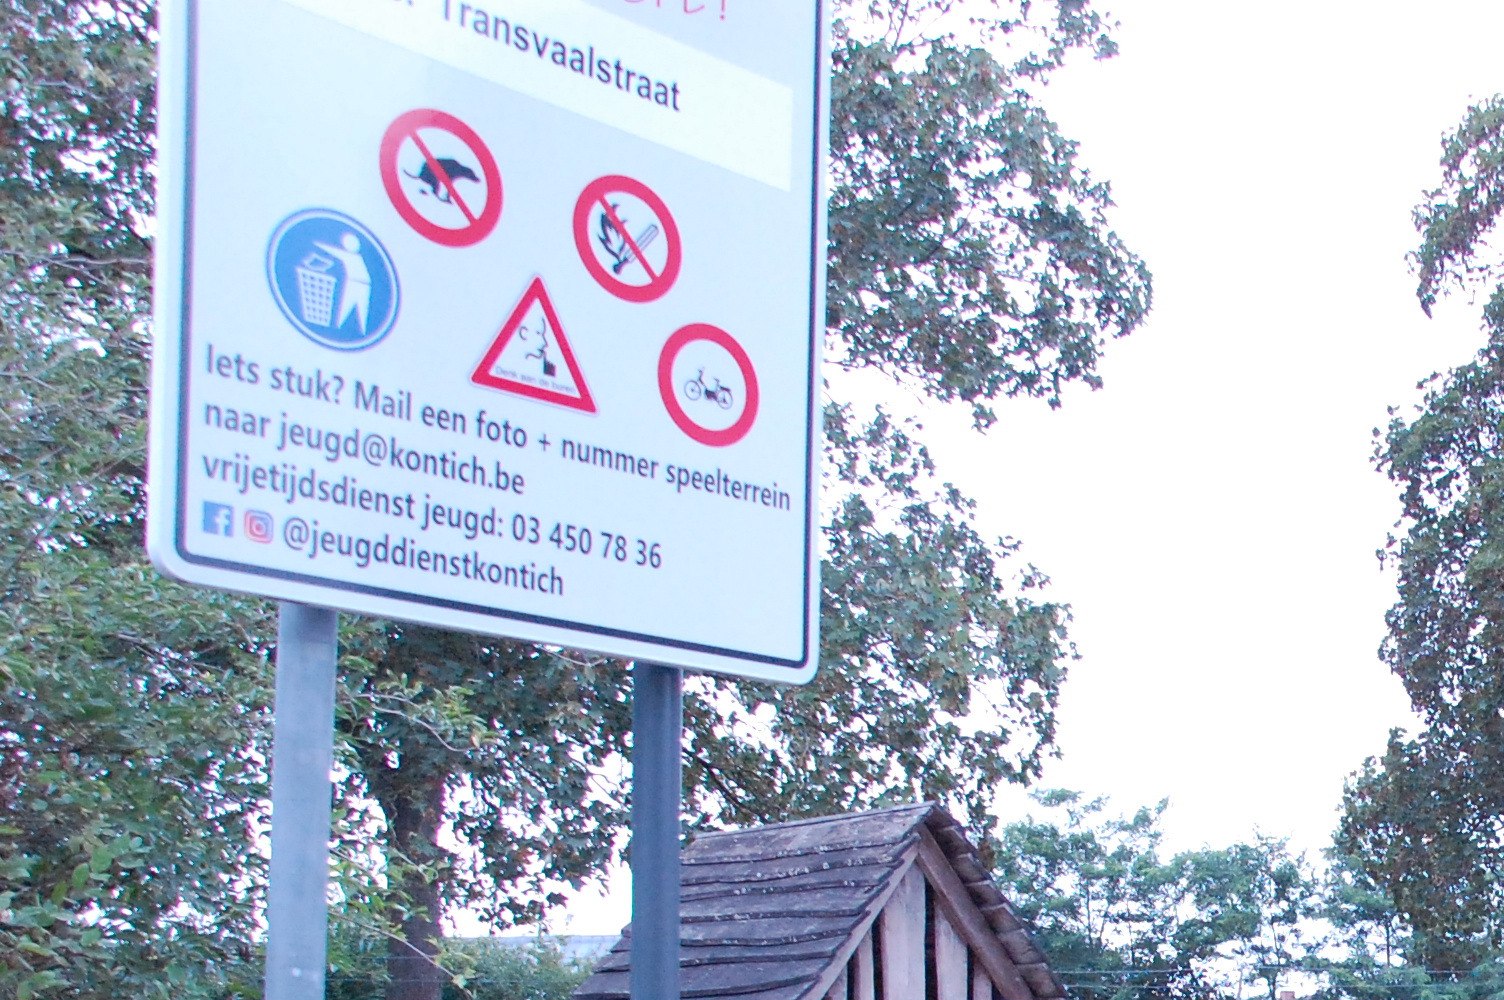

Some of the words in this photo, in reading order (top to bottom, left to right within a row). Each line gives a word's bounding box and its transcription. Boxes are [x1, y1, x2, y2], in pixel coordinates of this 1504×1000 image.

[204, 402, 271, 438] naar
[277, 411, 525, 494] jeugd@kontich.be
[206, 344, 260, 385] Iets
[270, 366, 345, 404] stuk?
[354, 380, 412, 421] Mail
[421, 405, 467, 434] een
[475, 410, 528, 448] foto
[538, 434, 551, 452] +
[561, 437, 660, 479] nummer
[666, 464, 792, 511] speelterrein
[203, 453, 415, 520] vrijetijdsdienst
[420, 494, 504, 540] jeugd:
[512, 513, 541, 545] 03
[549, 522, 593, 556] 450
[600, 531, 628, 563] 78
[635, 540, 663, 570] 36
[283, 517, 565, 596] @jeugddienstkontich
